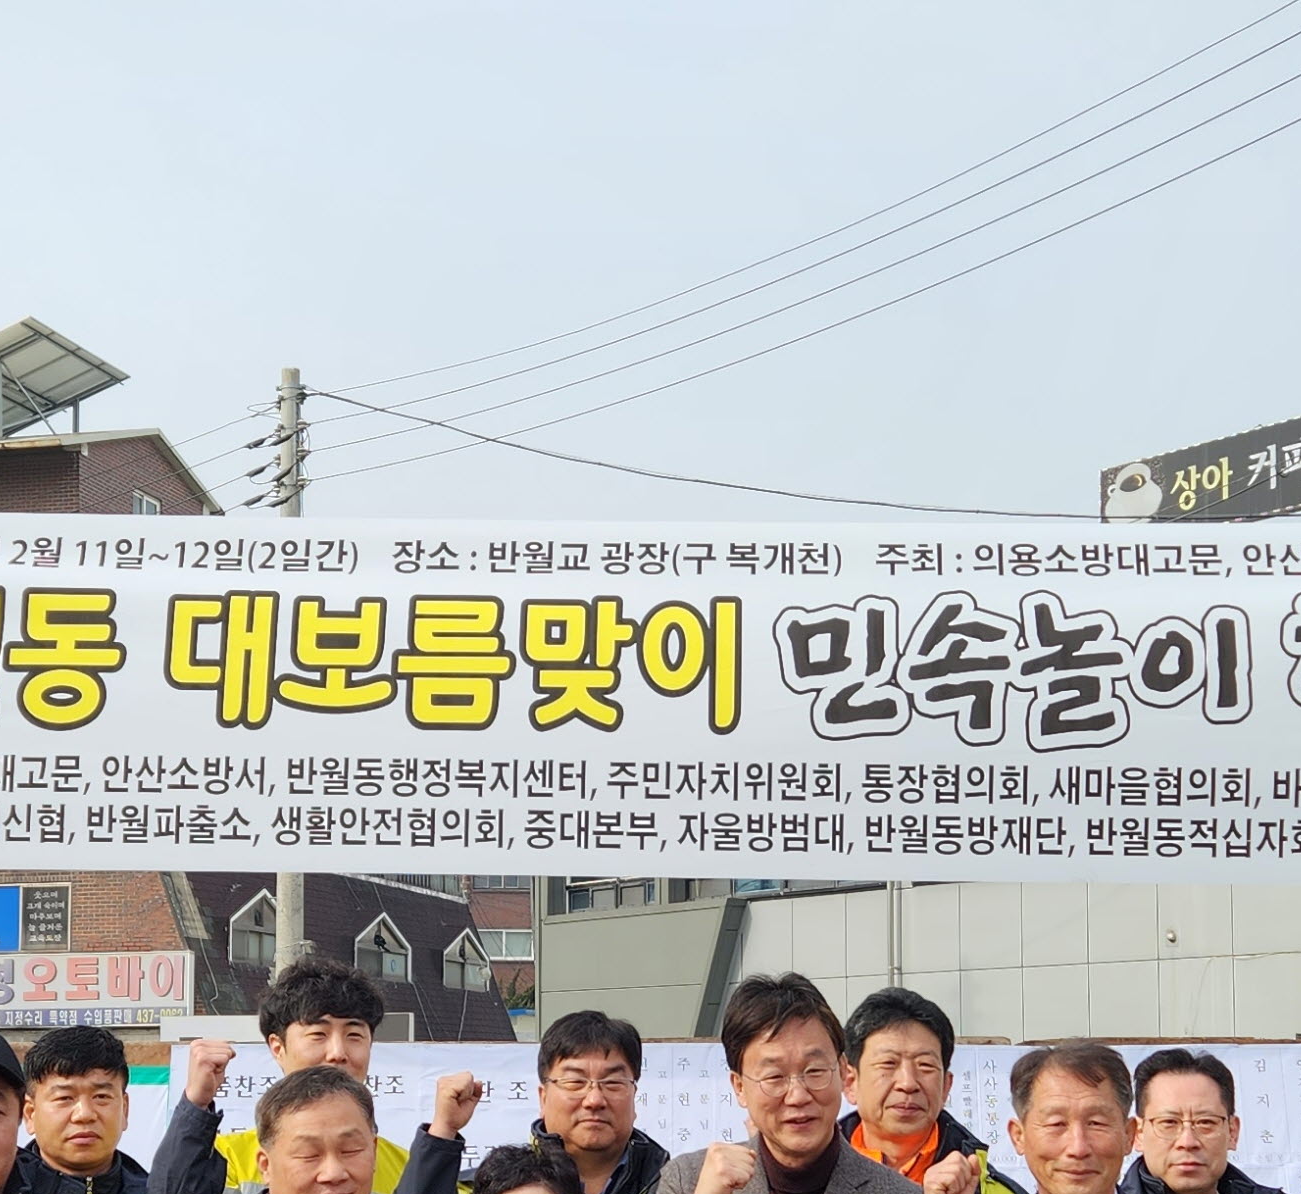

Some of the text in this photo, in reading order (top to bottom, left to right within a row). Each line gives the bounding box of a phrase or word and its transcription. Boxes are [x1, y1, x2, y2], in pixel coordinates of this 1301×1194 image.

[1170, 457, 1233, 511] 상아
[9, 537, 62, 567] 2월
[392, 540, 459, 573] 장소
[489, 541, 590, 573] 반월교
[601, 542, 716, 576] 광장(구
[726, 543, 841, 576] 복개천)
[876, 543, 942, 575] 주최
[973, 543, 1232, 577] 의용소방대고문,
[165, 590, 743, 735] 대보름맞이
[773, 590, 1252, 753] 민속놀이
[103, 755, 275, 797] 안산소방서,
[288, 757, 597, 801] 반월동행정복지센터,
[607, 761, 852, 804] 주민자치위원회,
[862, 764, 1039, 807] 통장협의회,
[1049, 766, 1261, 809] 새마을협의회,
[87, 805, 260, 847] 반월파출소,
[271, 807, 514, 850] 생활안전협의회,
[524, 810, 667, 852] 중대본부,
[866, 814, 1075, 858] 반월동방재단,
[5, 1010, 42, 1025] 지정수리
